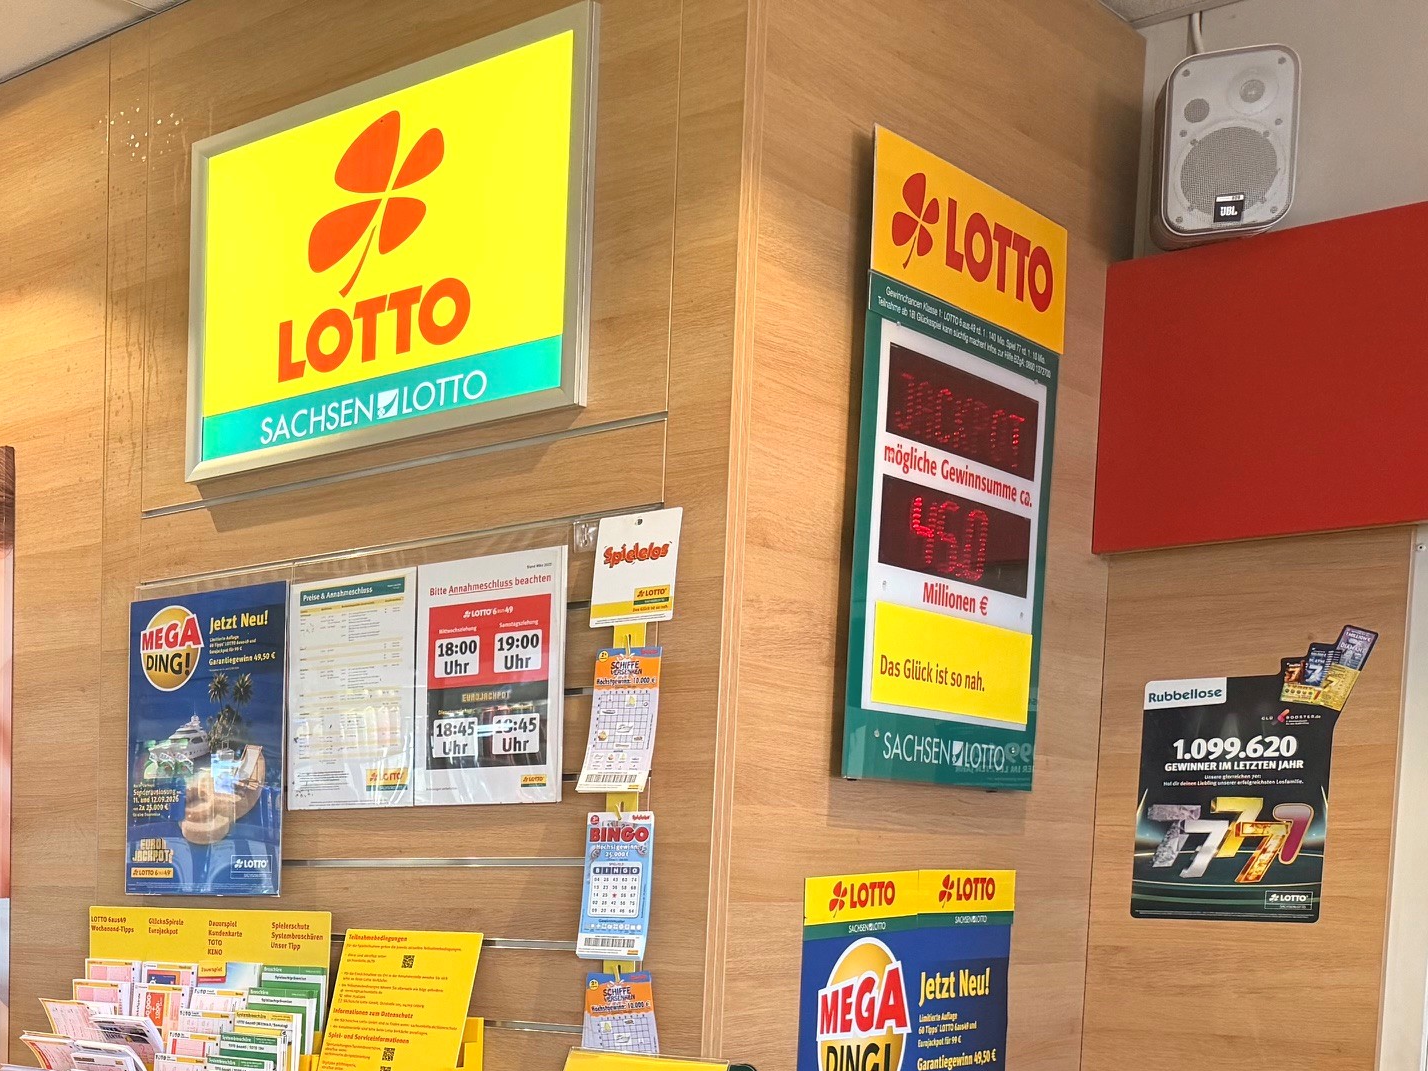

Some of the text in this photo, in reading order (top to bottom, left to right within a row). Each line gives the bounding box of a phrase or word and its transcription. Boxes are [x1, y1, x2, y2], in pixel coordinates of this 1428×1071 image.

[1221, 206, 1237, 216] JBL
[945, 197, 1053, 313] LOTTO
[277, 277, 471, 383] LOTTO
[260, 370, 488, 446] SACHSEN LOTTO
[884, 444, 1033, 507] mögliche Gewinnsumme ca.
[430, 574, 551, 596] Bitte Annahmeschluss beachten
[303, 593, 320, 602] Preise
[326, 587, 373, 599] Annahmeschluss
[923, 582, 989, 616] Millionen €
[209, 610, 269, 634] Jetzt Neu!
[499, 619, 539, 628] Samstagsziehung
[142, 617, 202, 651] MEGA
[438, 640, 477, 657] 18:00
[497, 633, 539, 652] 19:00
[147, 653, 191, 676] DING!
[444, 660, 469, 676] Uhr
[504, 654, 531, 670] Uhr
[880, 654, 985, 692] Das Glück ist so nah.
[462, 691, 510, 702] EUROJACKPOT
[1148, 688, 1222, 703] Rubbellose
[436, 721, 475, 737] 18:45
[443, 740, 468, 755] Uhr
[503, 737, 529, 752] Uhr
[883, 732, 1005, 771] SACHSEN LOTTO
[1173, 735, 1297, 760] 1.099.620
[1165, 760, 1304, 772] GEWINNER IM LETZTEN JAHR
[589, 827, 650, 843] BINGO
[244, 860, 267, 868] LOTTO
[850, 880, 896, 909] LOTTO
[956, 877, 996, 901] LOTTO
[209, 920, 237, 929] Dauerspiel
[272, 922, 310, 930] Spielerschutz
[208, 930, 242, 938] Kundenkarte
[271, 931, 323, 941] Systembroschüren
[349, 934, 407, 942] Teilnahmebedingungen
[207, 948, 223, 956] KENO
[270, 942, 301, 951] Unser Tipp
[919, 968, 991, 1007] Jetzt Neu!
[819, 966, 908, 1035] MEGA
[917, 1048, 996, 1071] Garantiegewinn 49,50 €
